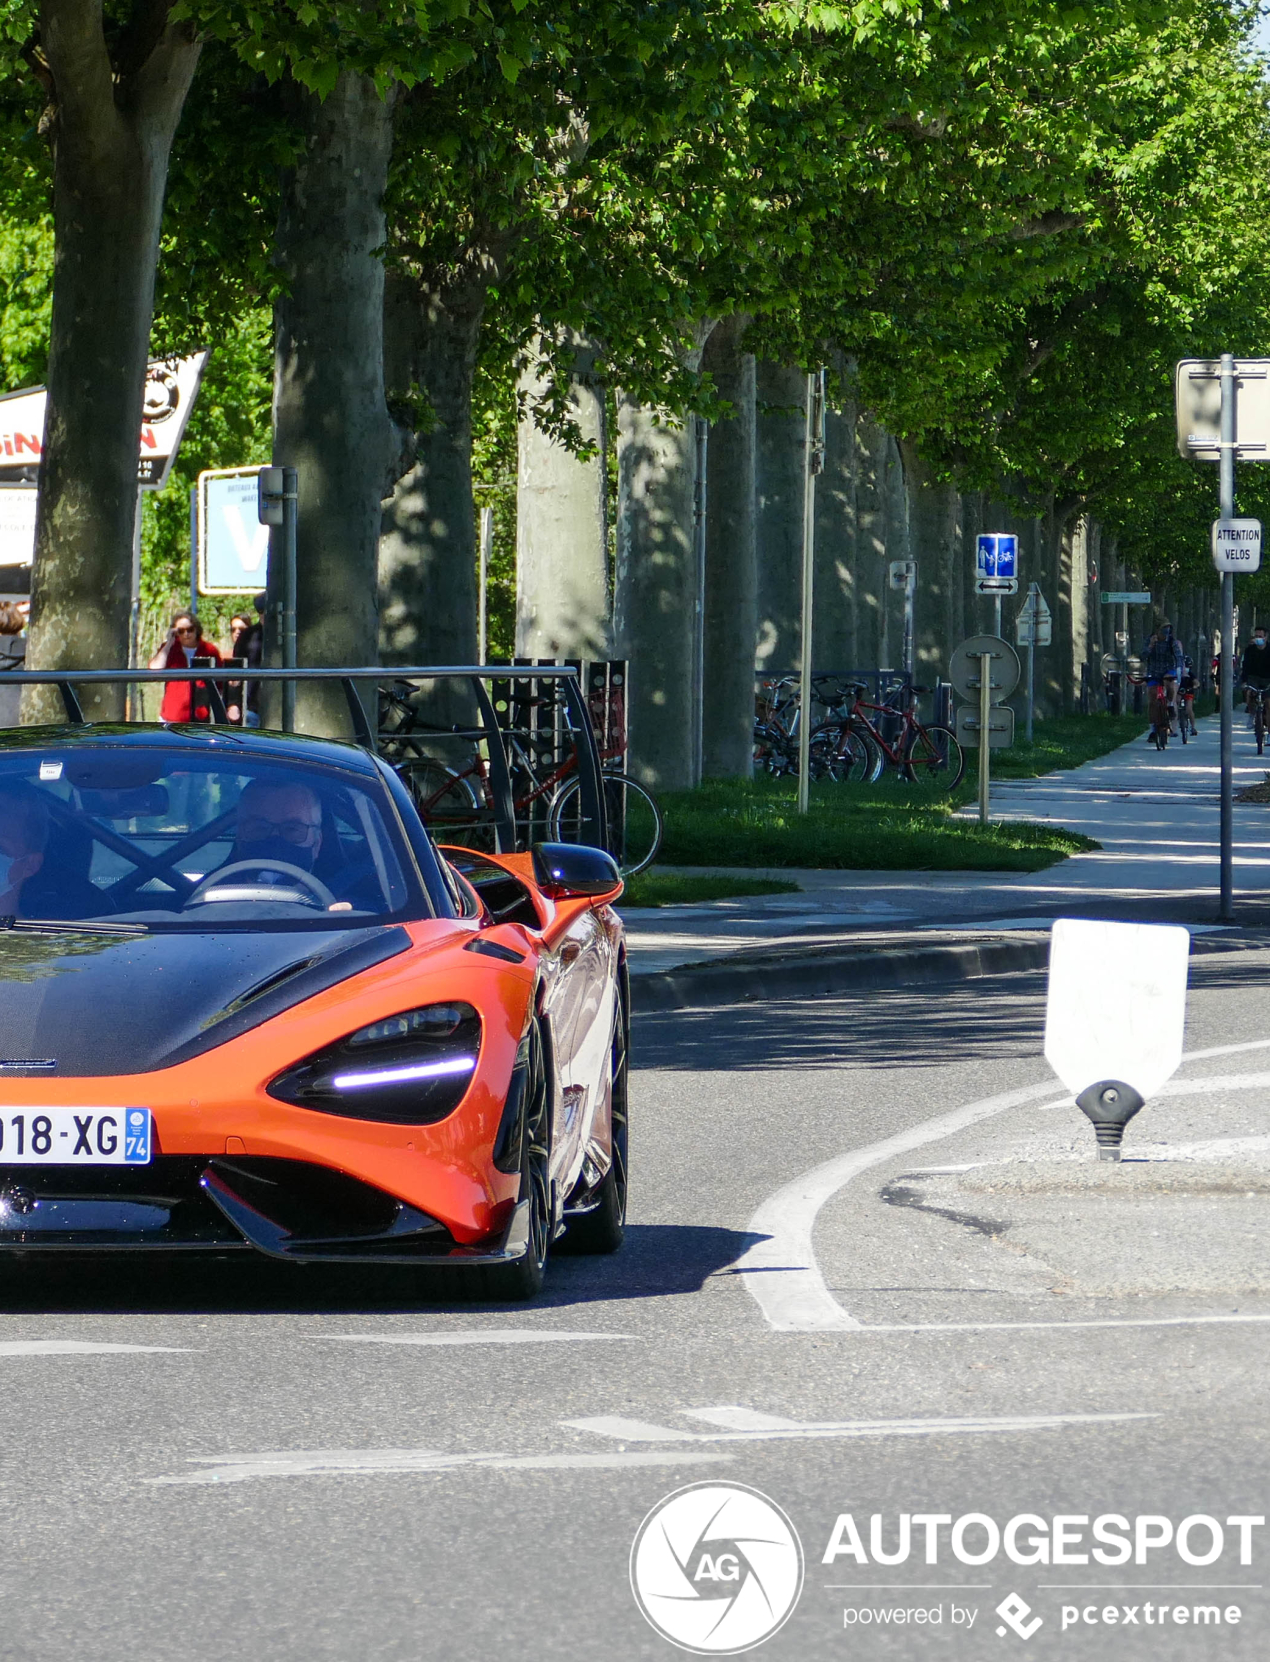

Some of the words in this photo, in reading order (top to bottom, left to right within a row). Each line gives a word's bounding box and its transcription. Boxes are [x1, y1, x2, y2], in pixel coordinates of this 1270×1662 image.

[1217, 529, 1260, 541] ATTENTION
[1225, 548, 1251, 561] VELOS
[126, 1137, 147, 1156] 74
